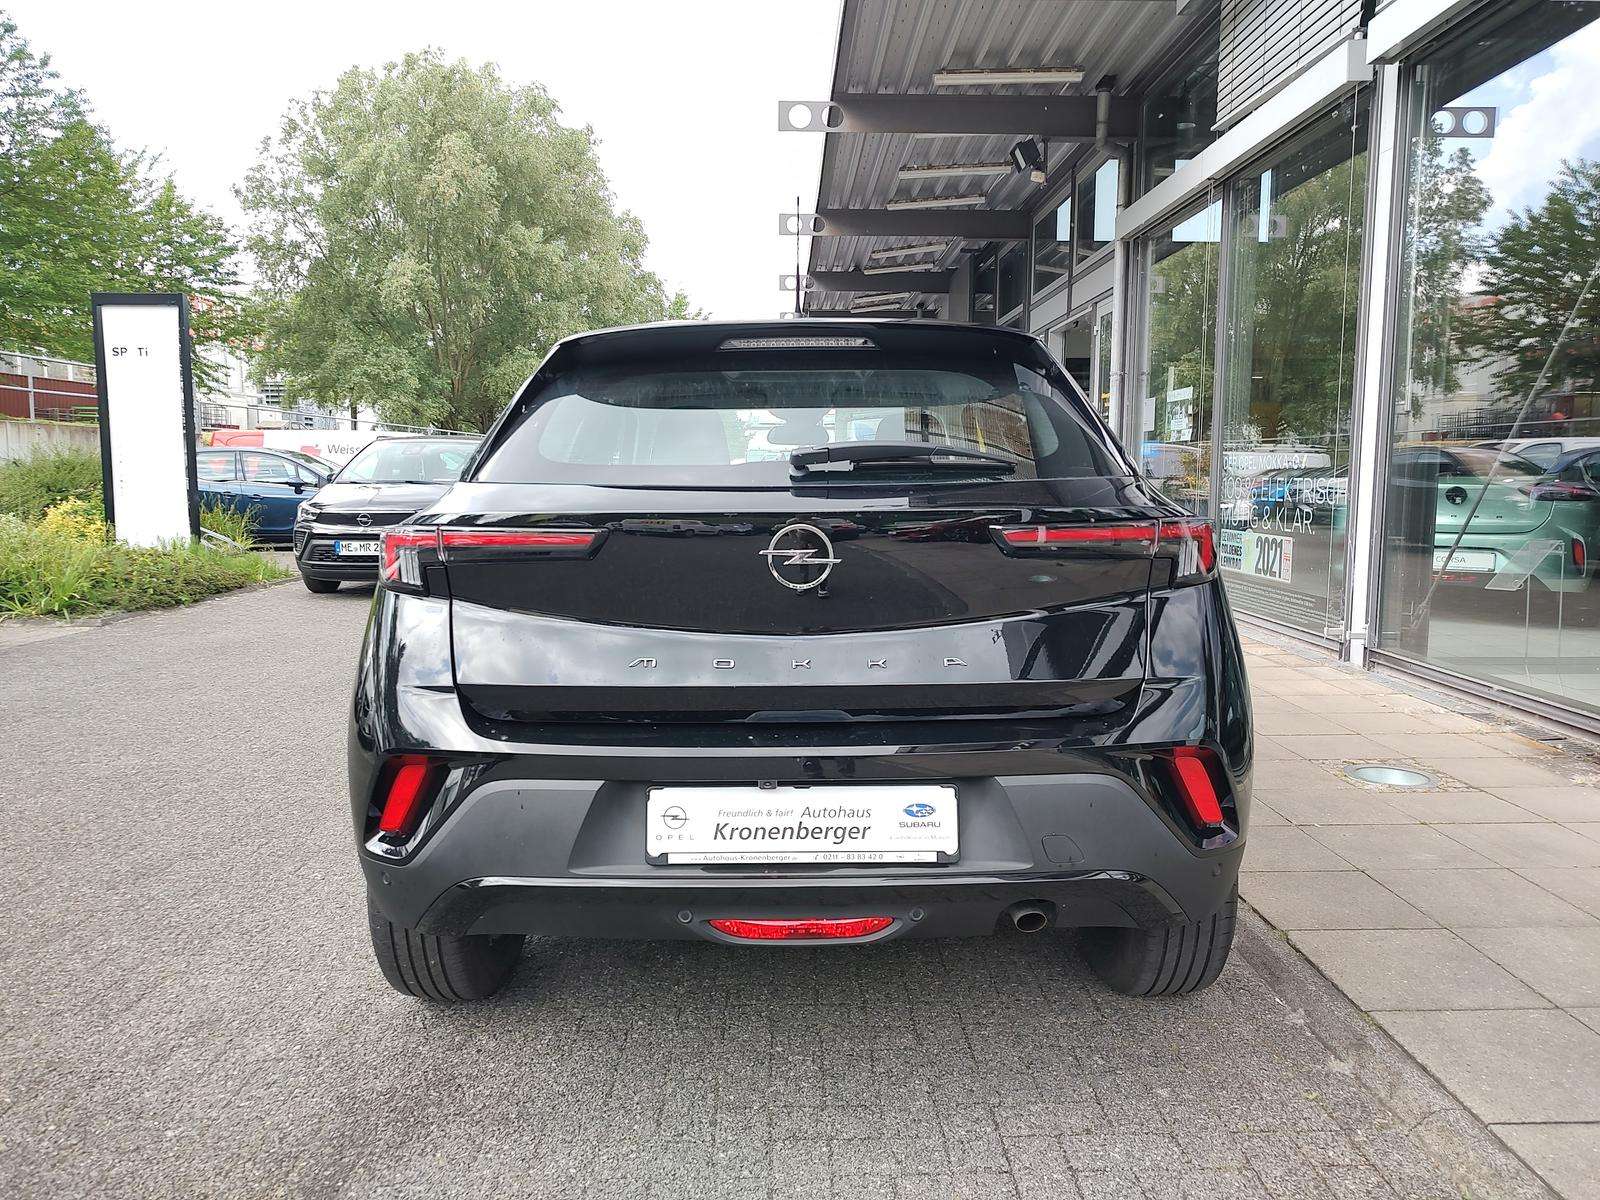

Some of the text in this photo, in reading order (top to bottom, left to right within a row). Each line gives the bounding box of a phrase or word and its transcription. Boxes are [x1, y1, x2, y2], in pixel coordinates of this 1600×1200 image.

[1261, 506, 1273, 530] &
[358, 543, 371, 553] MR
[1254, 535, 1283, 579] 2021
[628, 656, 968, 670] MOKKA
[717, 808, 764, 818] Freundlich
[766, 809, 773, 818] &
[801, 805, 872, 819] Autohaus
[898, 821, 942, 829] SUBARU
[655, 834, 695, 842] OPEL
[713, 821, 872, 845] Kronenberger
